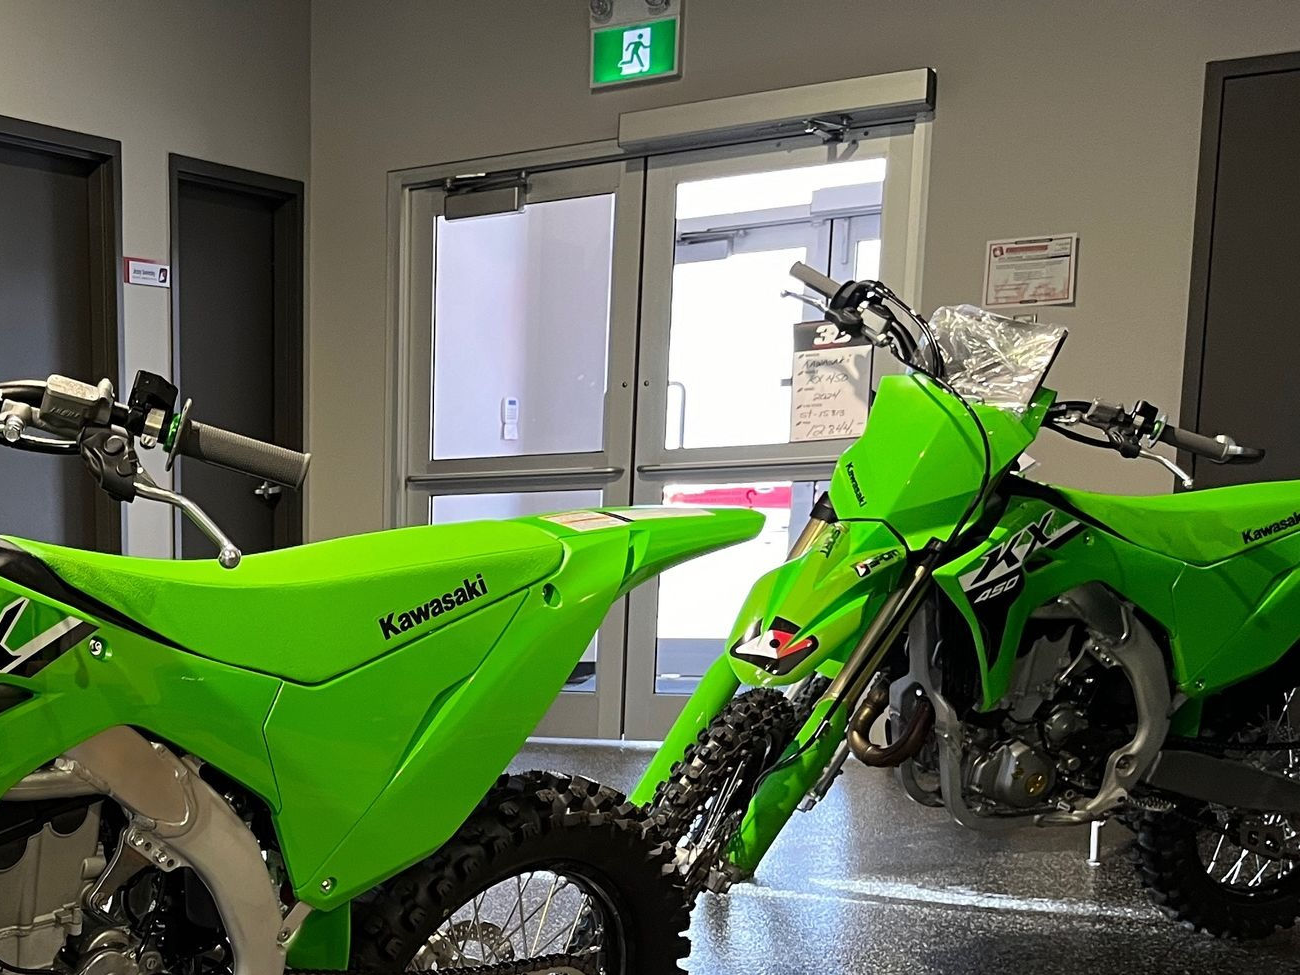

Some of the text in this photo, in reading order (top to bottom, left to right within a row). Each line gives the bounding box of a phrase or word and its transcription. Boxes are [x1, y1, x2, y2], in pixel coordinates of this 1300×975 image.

[969, 508, 1053, 588] KX
[1242, 512, 1300, 544] Kawasak
[378, 573, 489, 640] Kawasaki
[973, 575, 1020, 604] 450
